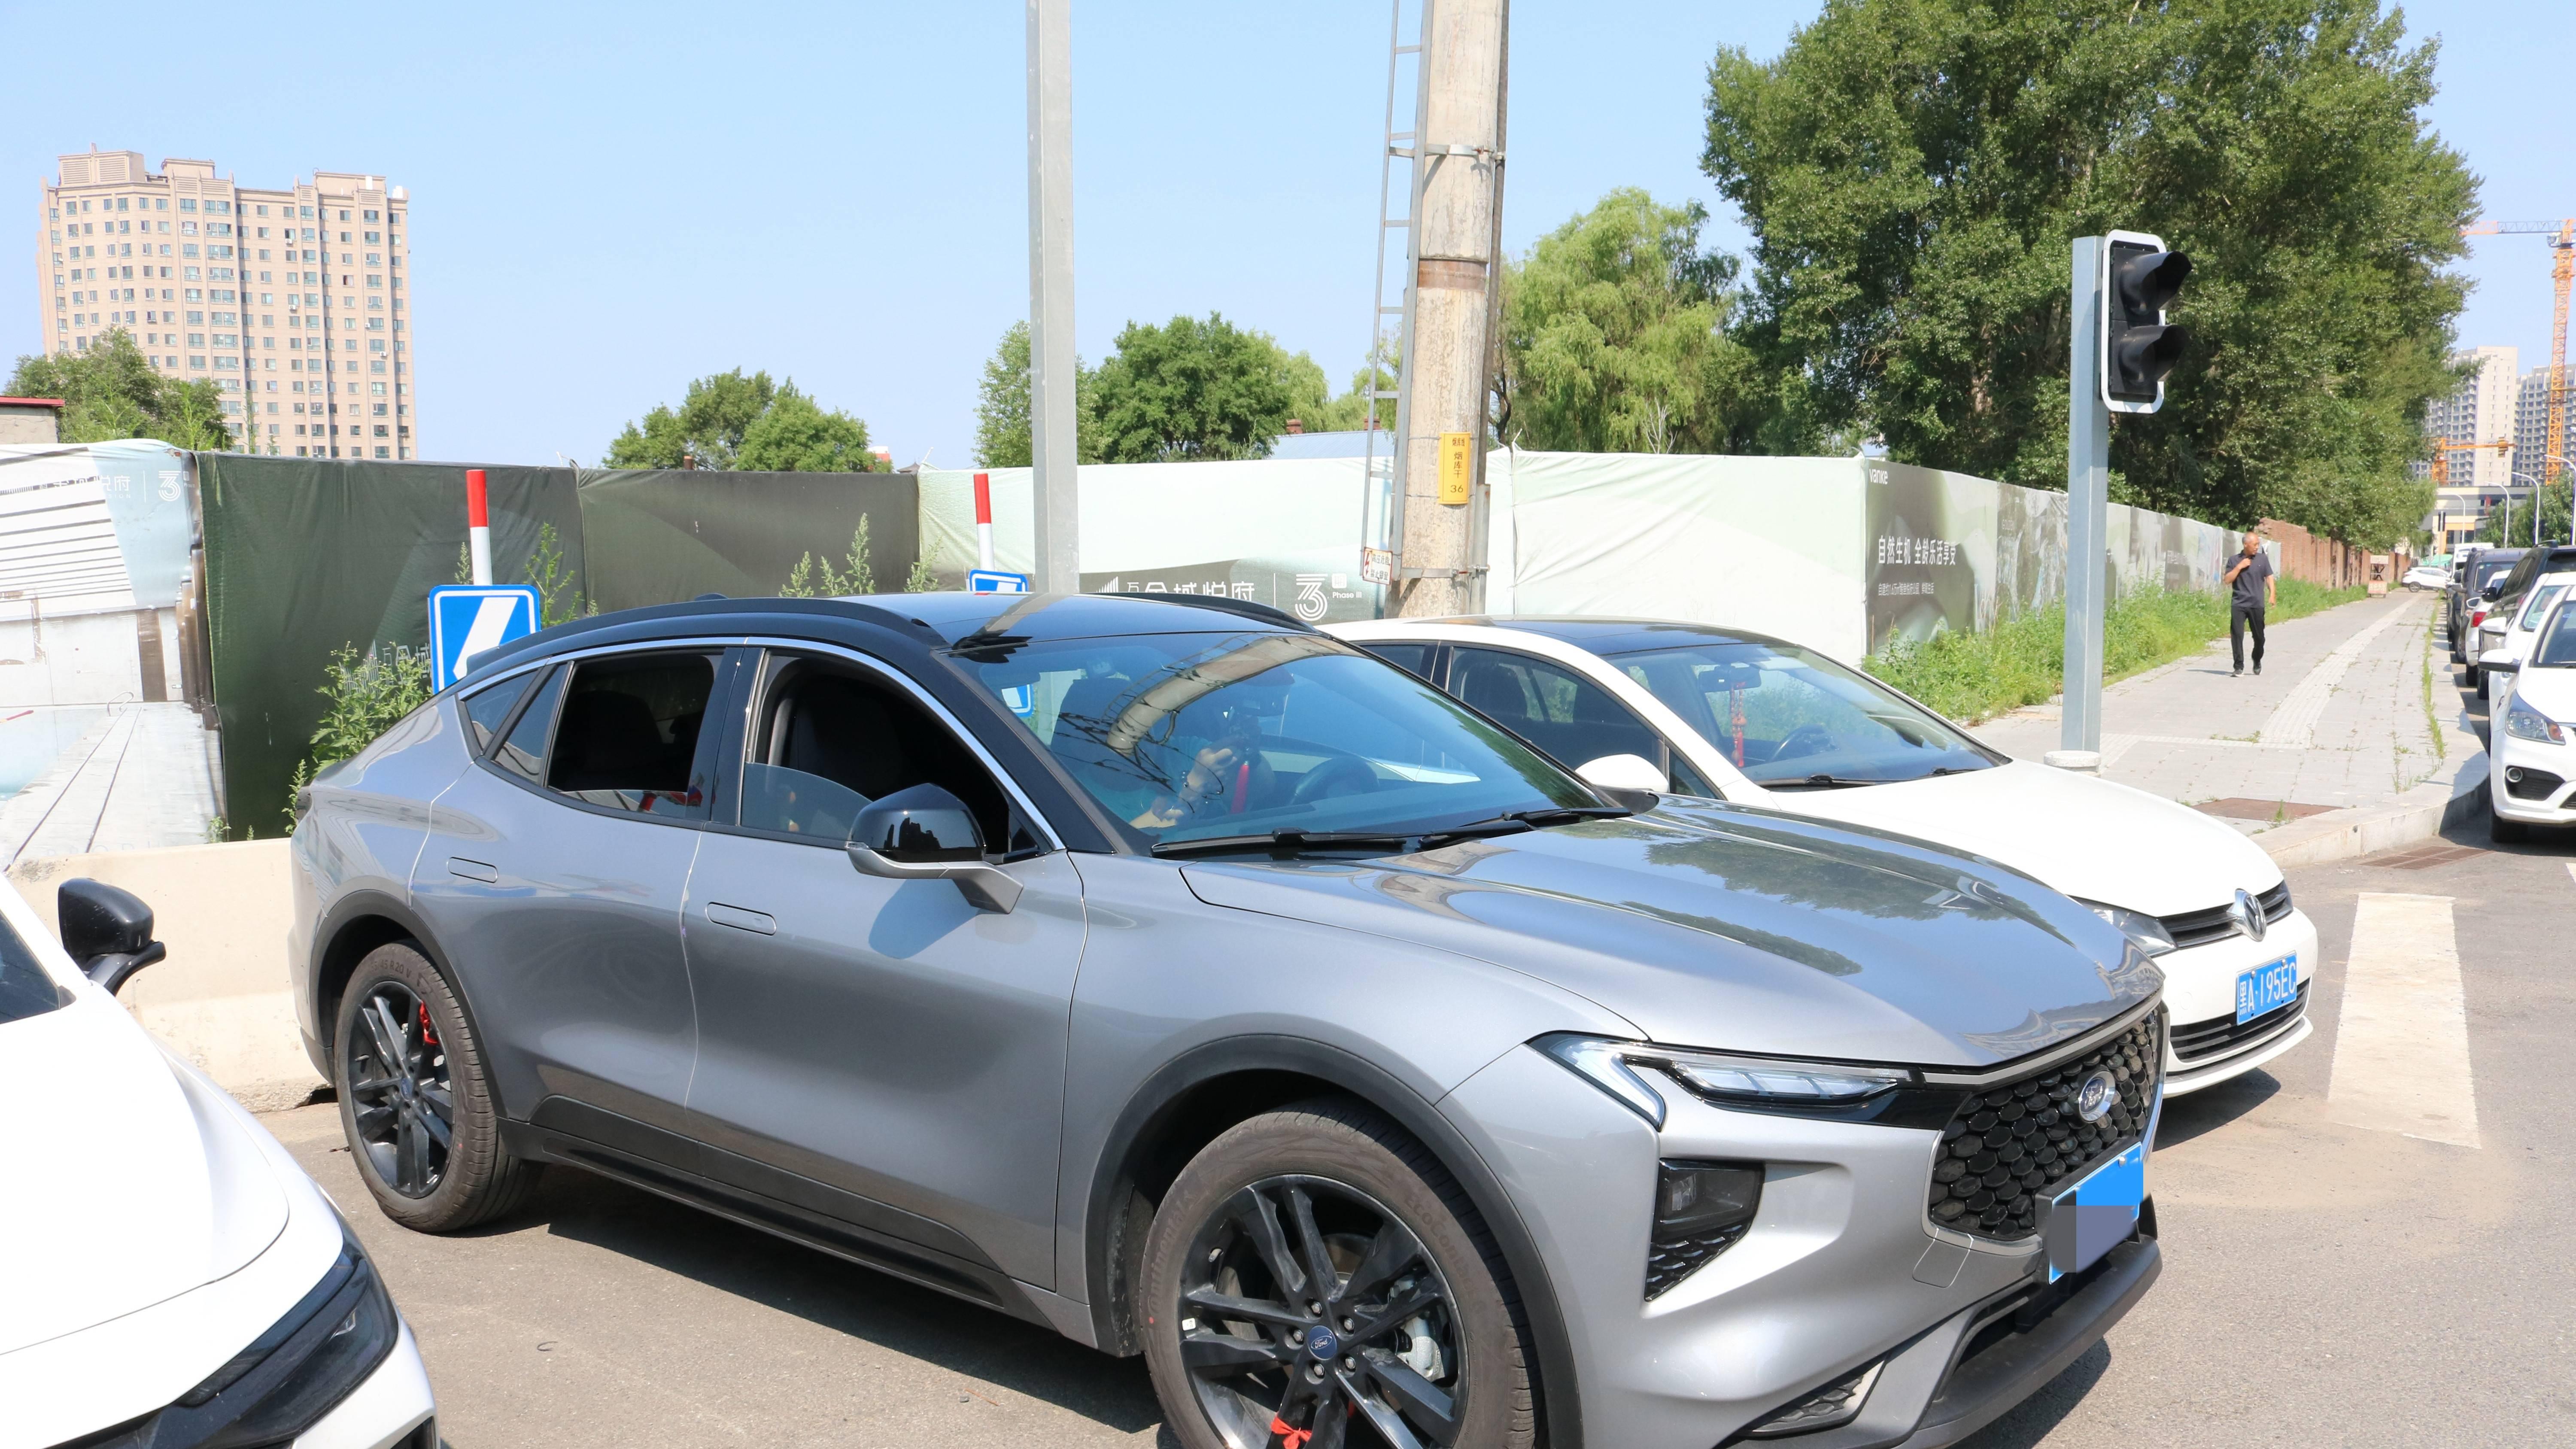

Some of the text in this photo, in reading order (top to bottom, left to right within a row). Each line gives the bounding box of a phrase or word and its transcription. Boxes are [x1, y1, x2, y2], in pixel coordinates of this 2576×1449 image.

[1869, 468, 1888, 485] vanke
[1450, 485, 1464, 493] 36
[1878, 535, 1911, 565] 自然生机
[1315, 1338, 1328, 1349] Ford
